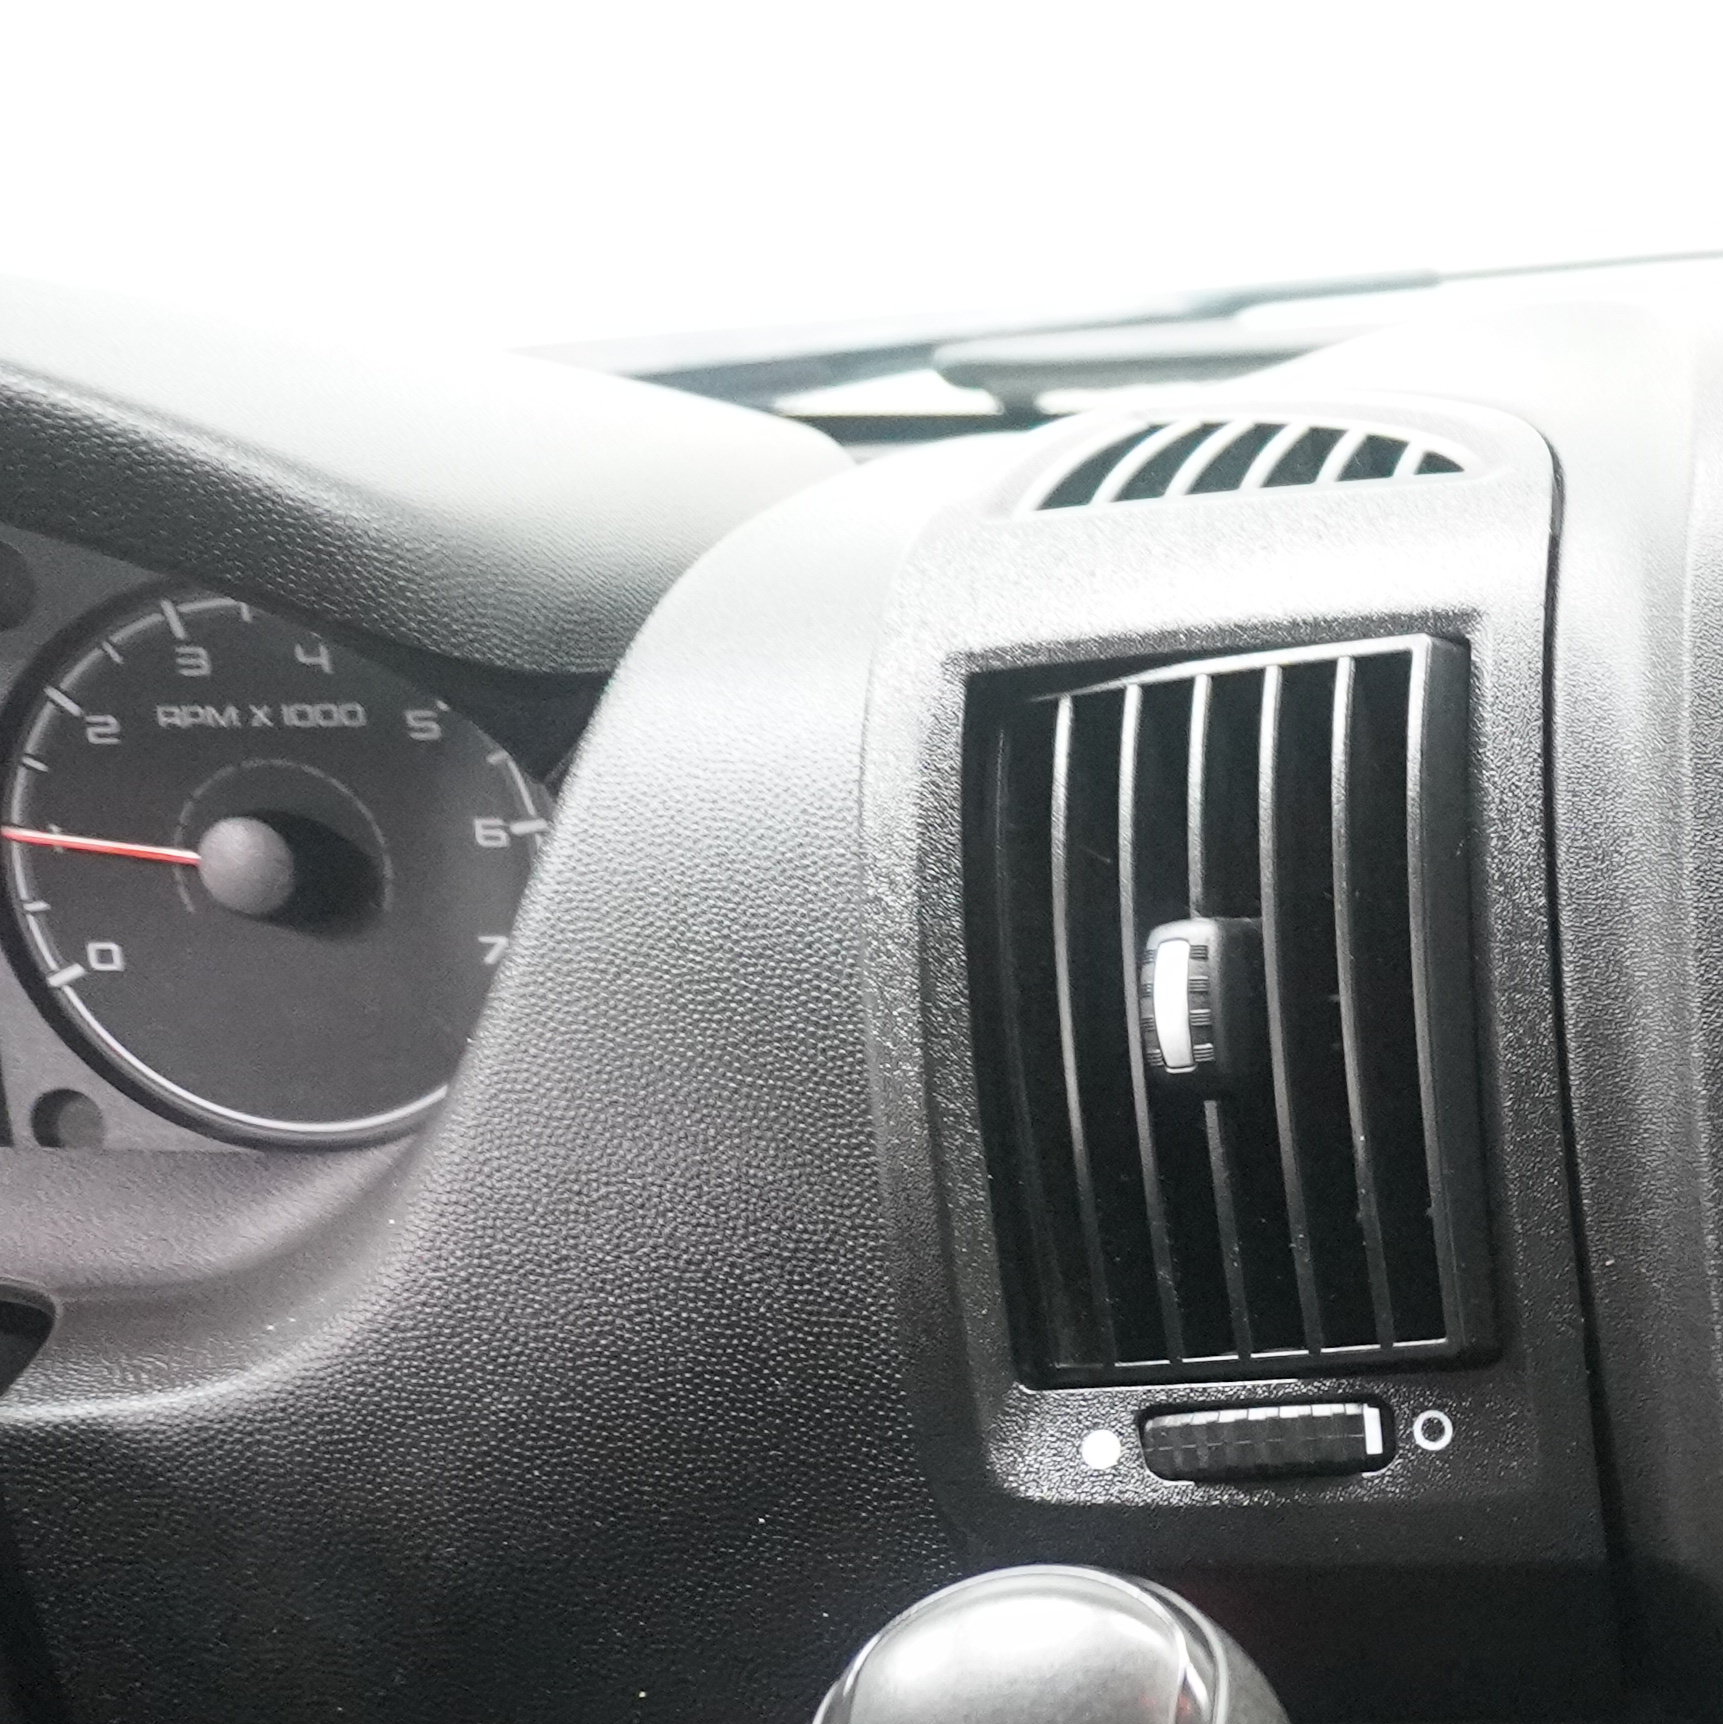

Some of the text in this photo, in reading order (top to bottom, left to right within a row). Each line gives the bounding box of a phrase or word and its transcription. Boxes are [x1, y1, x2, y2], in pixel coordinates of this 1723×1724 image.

[176, 646, 211, 676] 3
[295, 643, 332, 673] 4
[85, 715, 120, 744] 2
[156, 705, 241, 728] RPM
[281, 702, 366, 727] 1000
[406, 711, 441, 741] 5
[474, 818, 512, 847] 6
